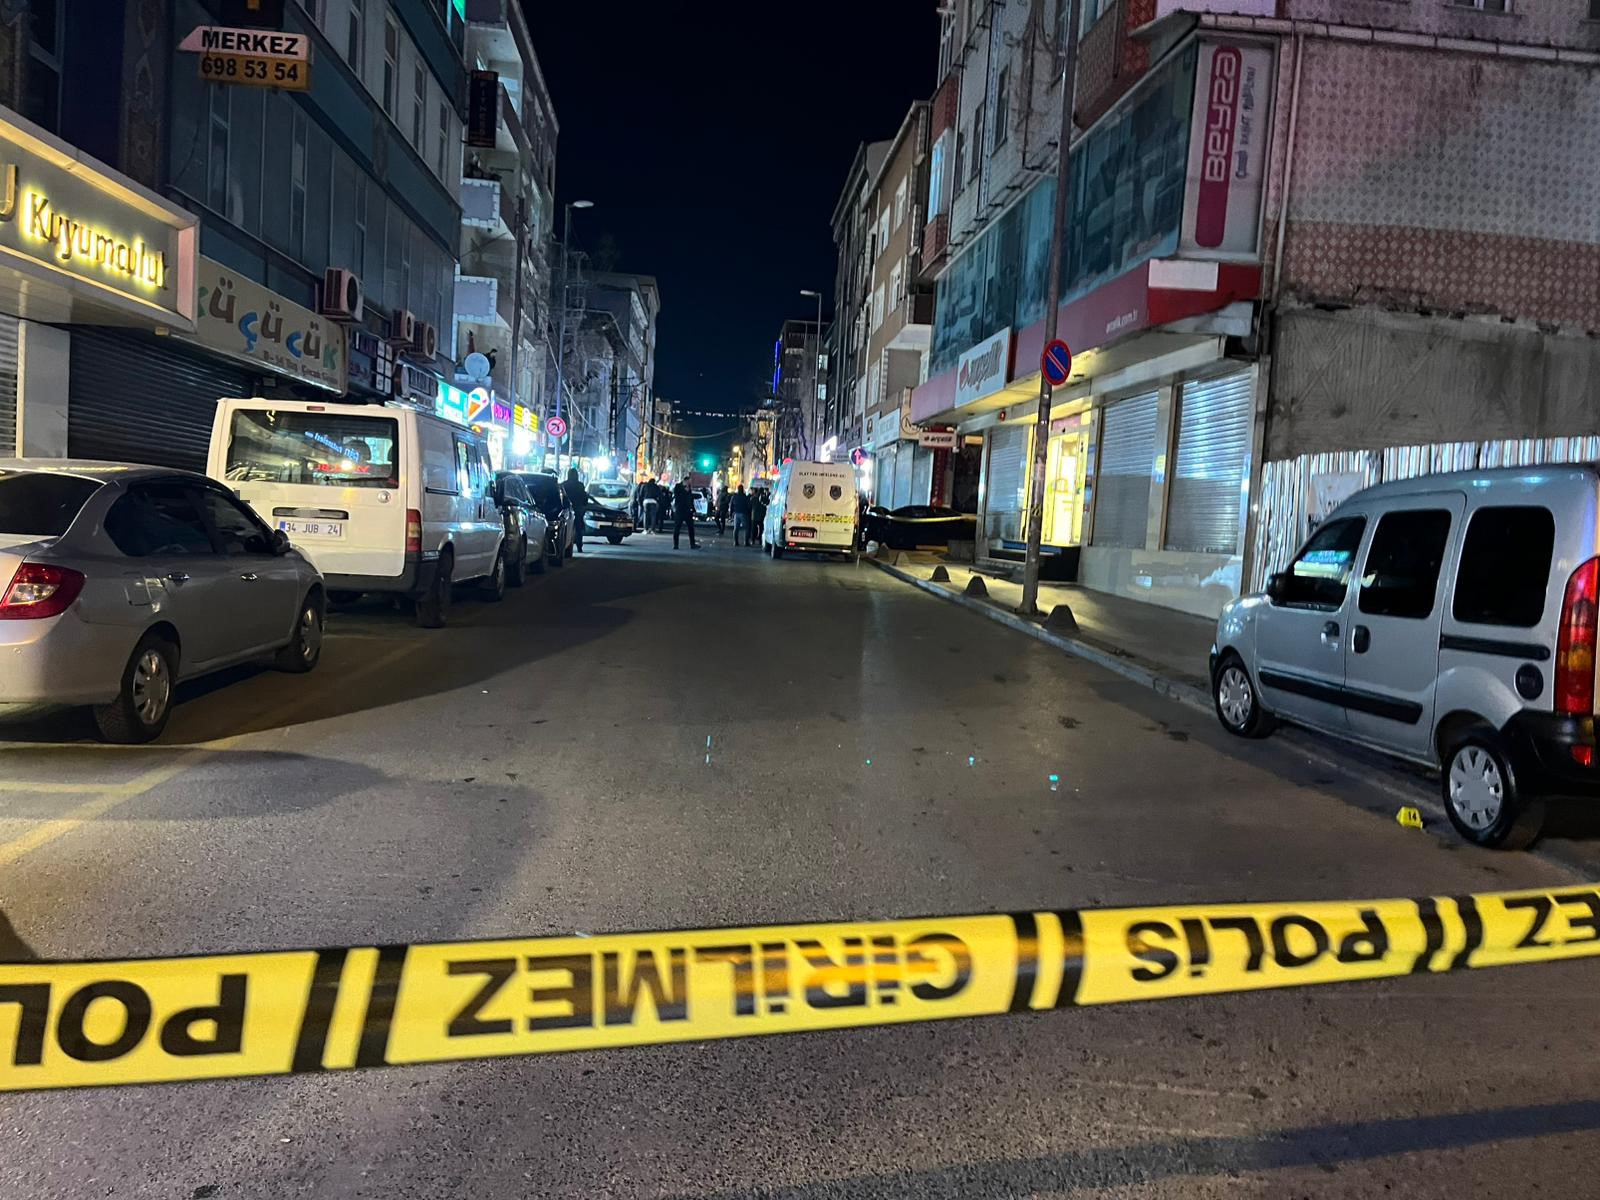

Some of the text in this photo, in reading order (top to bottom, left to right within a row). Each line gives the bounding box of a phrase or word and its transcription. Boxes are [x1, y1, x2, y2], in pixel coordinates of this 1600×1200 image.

[201, 29, 299, 55] MERKEZ
[201, 57, 298, 81] 698 53 54
[285, 522, 339, 535] 34 JUB 24
[1126, 910, 1391, 982] POLİS
[445, 930, 974, 1038] GİRİLMEZ
